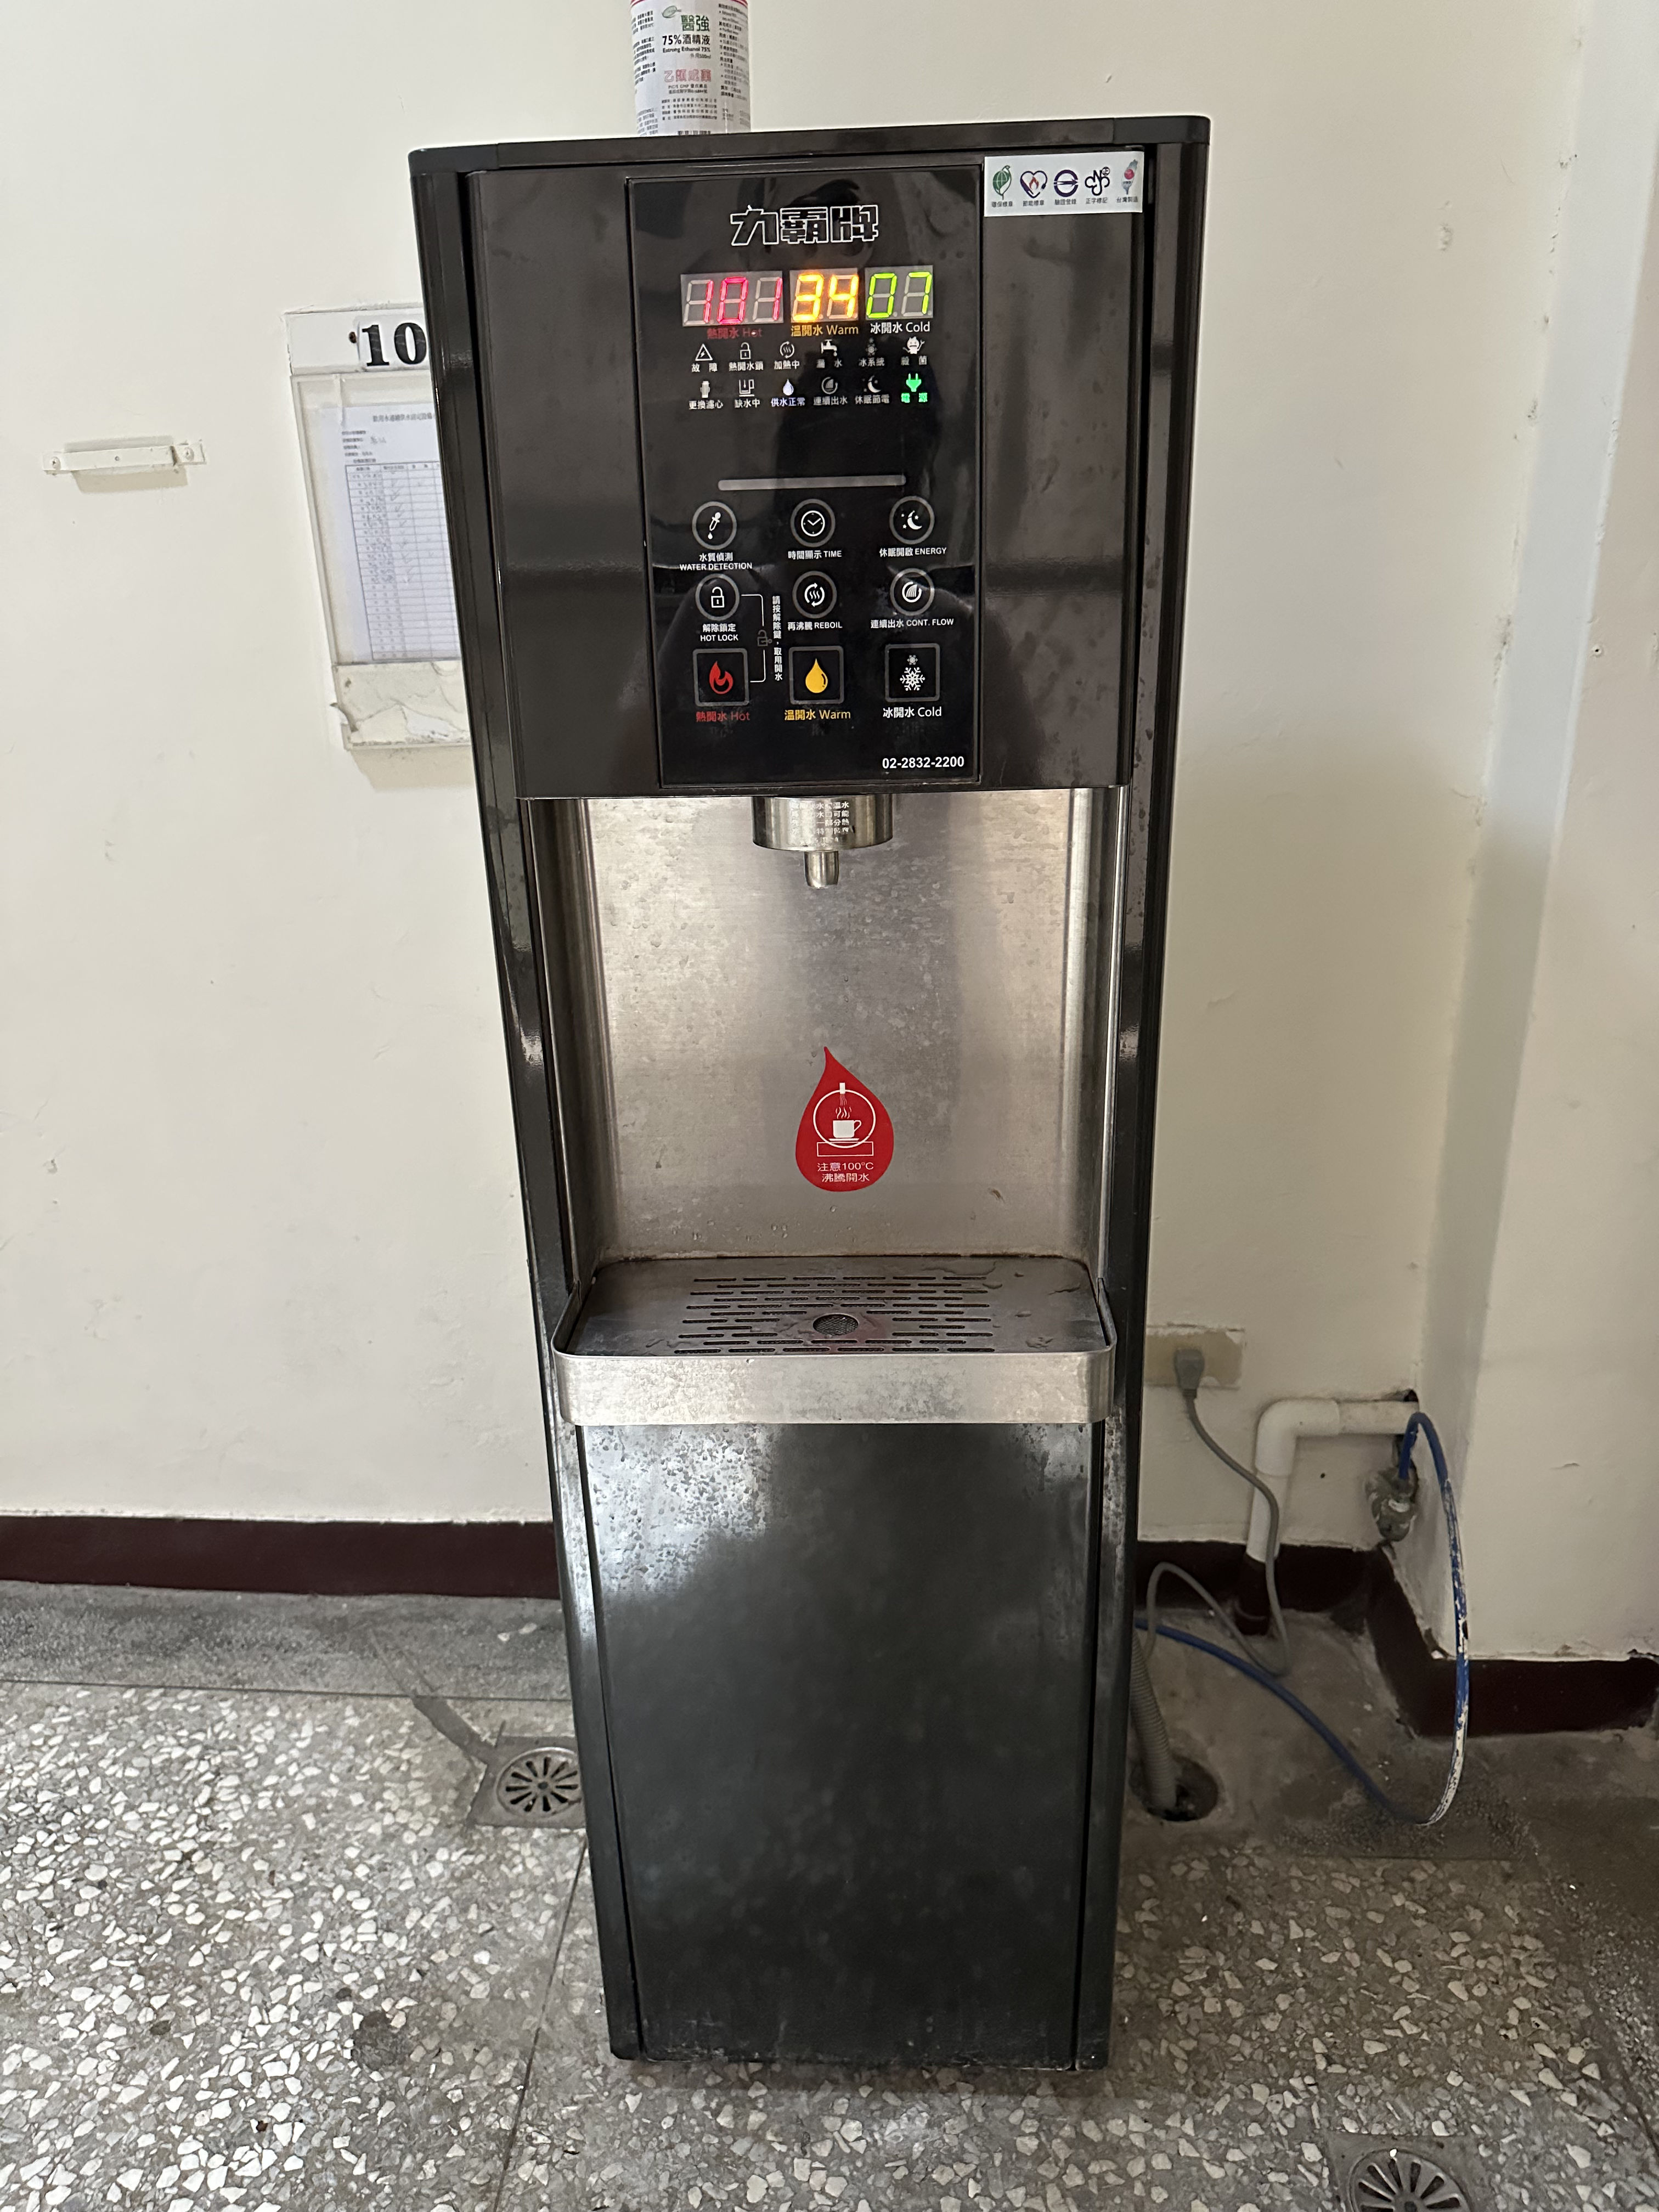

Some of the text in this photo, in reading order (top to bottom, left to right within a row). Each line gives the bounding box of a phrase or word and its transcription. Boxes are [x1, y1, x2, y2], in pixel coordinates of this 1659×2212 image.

[681, 15, 710, 32] 醫強
[730, 205, 878, 246] 力霸牌
[703, 276, 783, 325] 101
[793, 273, 859, 322] 34
[866, 272, 932, 319] 07
[826, 325, 859, 335] Warm
[870, 321, 930, 334] 冰開水 Cold
[707, 328, 762, 339] 熱開水 Hot
[362, 323, 427, 366] 10
[729, 361, 764, 371] 熱開水鎖
[774, 360, 800, 370] 加熱中
[859, 358, 885, 366] 冰系統
[735, 398, 760, 408] 缺水中
[771, 397, 805, 407] 供水正常
[813, 396, 848, 405] 連續出水
[855, 394, 889, 404] 休眠節電
[689, 399, 724, 410] 更換濾心
[699, 552, 733, 562] 水質偵測
[788, 550, 822, 560] 時間顯示
[702, 623, 736, 632] 解除鎖定
[788, 622, 812, 631] 再沸騰
[871, 619, 904, 628] 連續出水
[696, 711, 750, 722] 熱開水 Hot
[820, 710, 851, 720] Warm
[883, 707, 942, 719] 冰開水 Cold
[882, 757, 964, 769] 02-2832-2200
[822, 1173, 870, 1182] 沸騰開水
